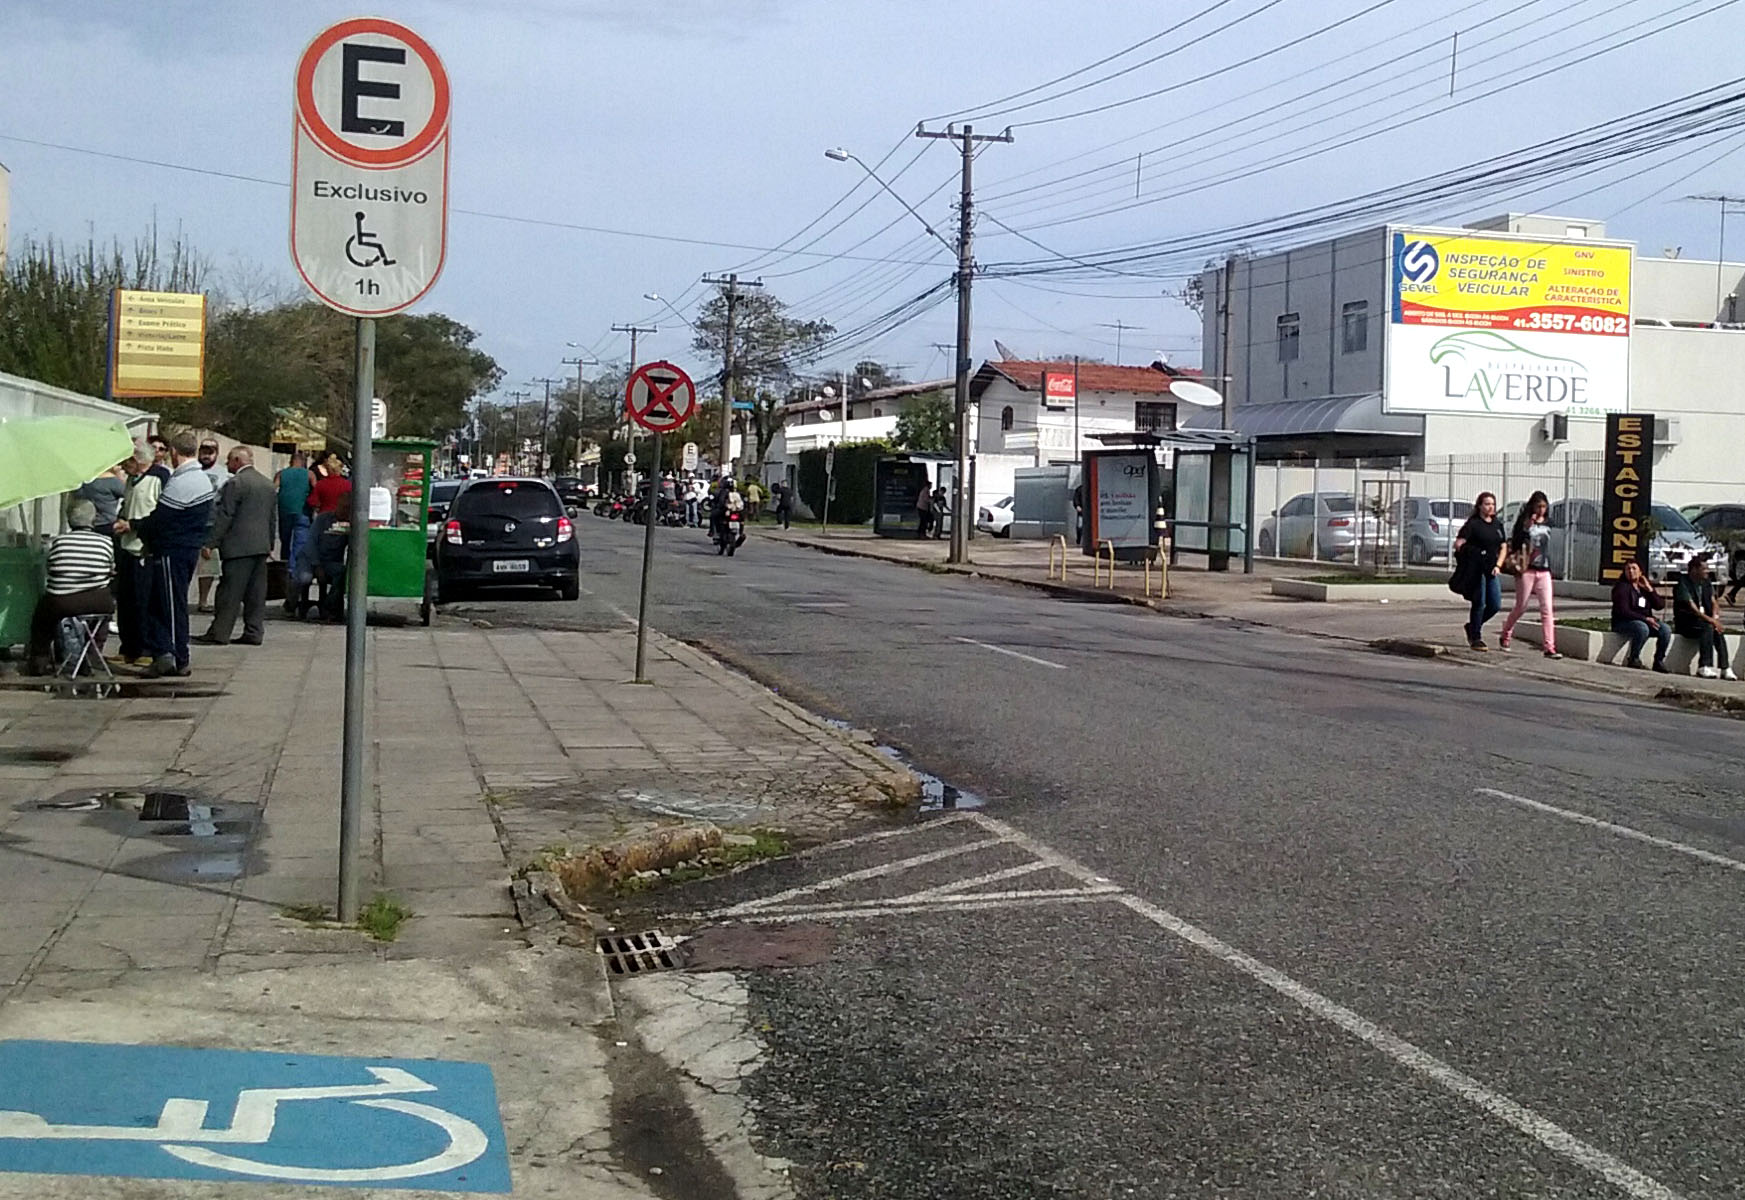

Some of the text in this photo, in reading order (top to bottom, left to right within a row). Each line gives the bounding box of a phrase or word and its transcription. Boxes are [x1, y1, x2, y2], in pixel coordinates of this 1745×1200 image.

[341, 42, 406, 137] E
[313, 180, 428, 204] Exclusivo
[1444, 253, 1547, 270] INSPEÇÃO DE
[1574, 250, 1595, 259] GNV
[1448, 267, 1539, 283] SEGURANÇA
[1563, 268, 1605, 278] SINISTRO
[353, 278, 380, 295] 1h
[1400, 283, 1439, 294] SEVEL
[1457, 282, 1530, 297] VEICULAR
[1606, 288, 1619, 296] DE
[687, 444, 694, 455] E
